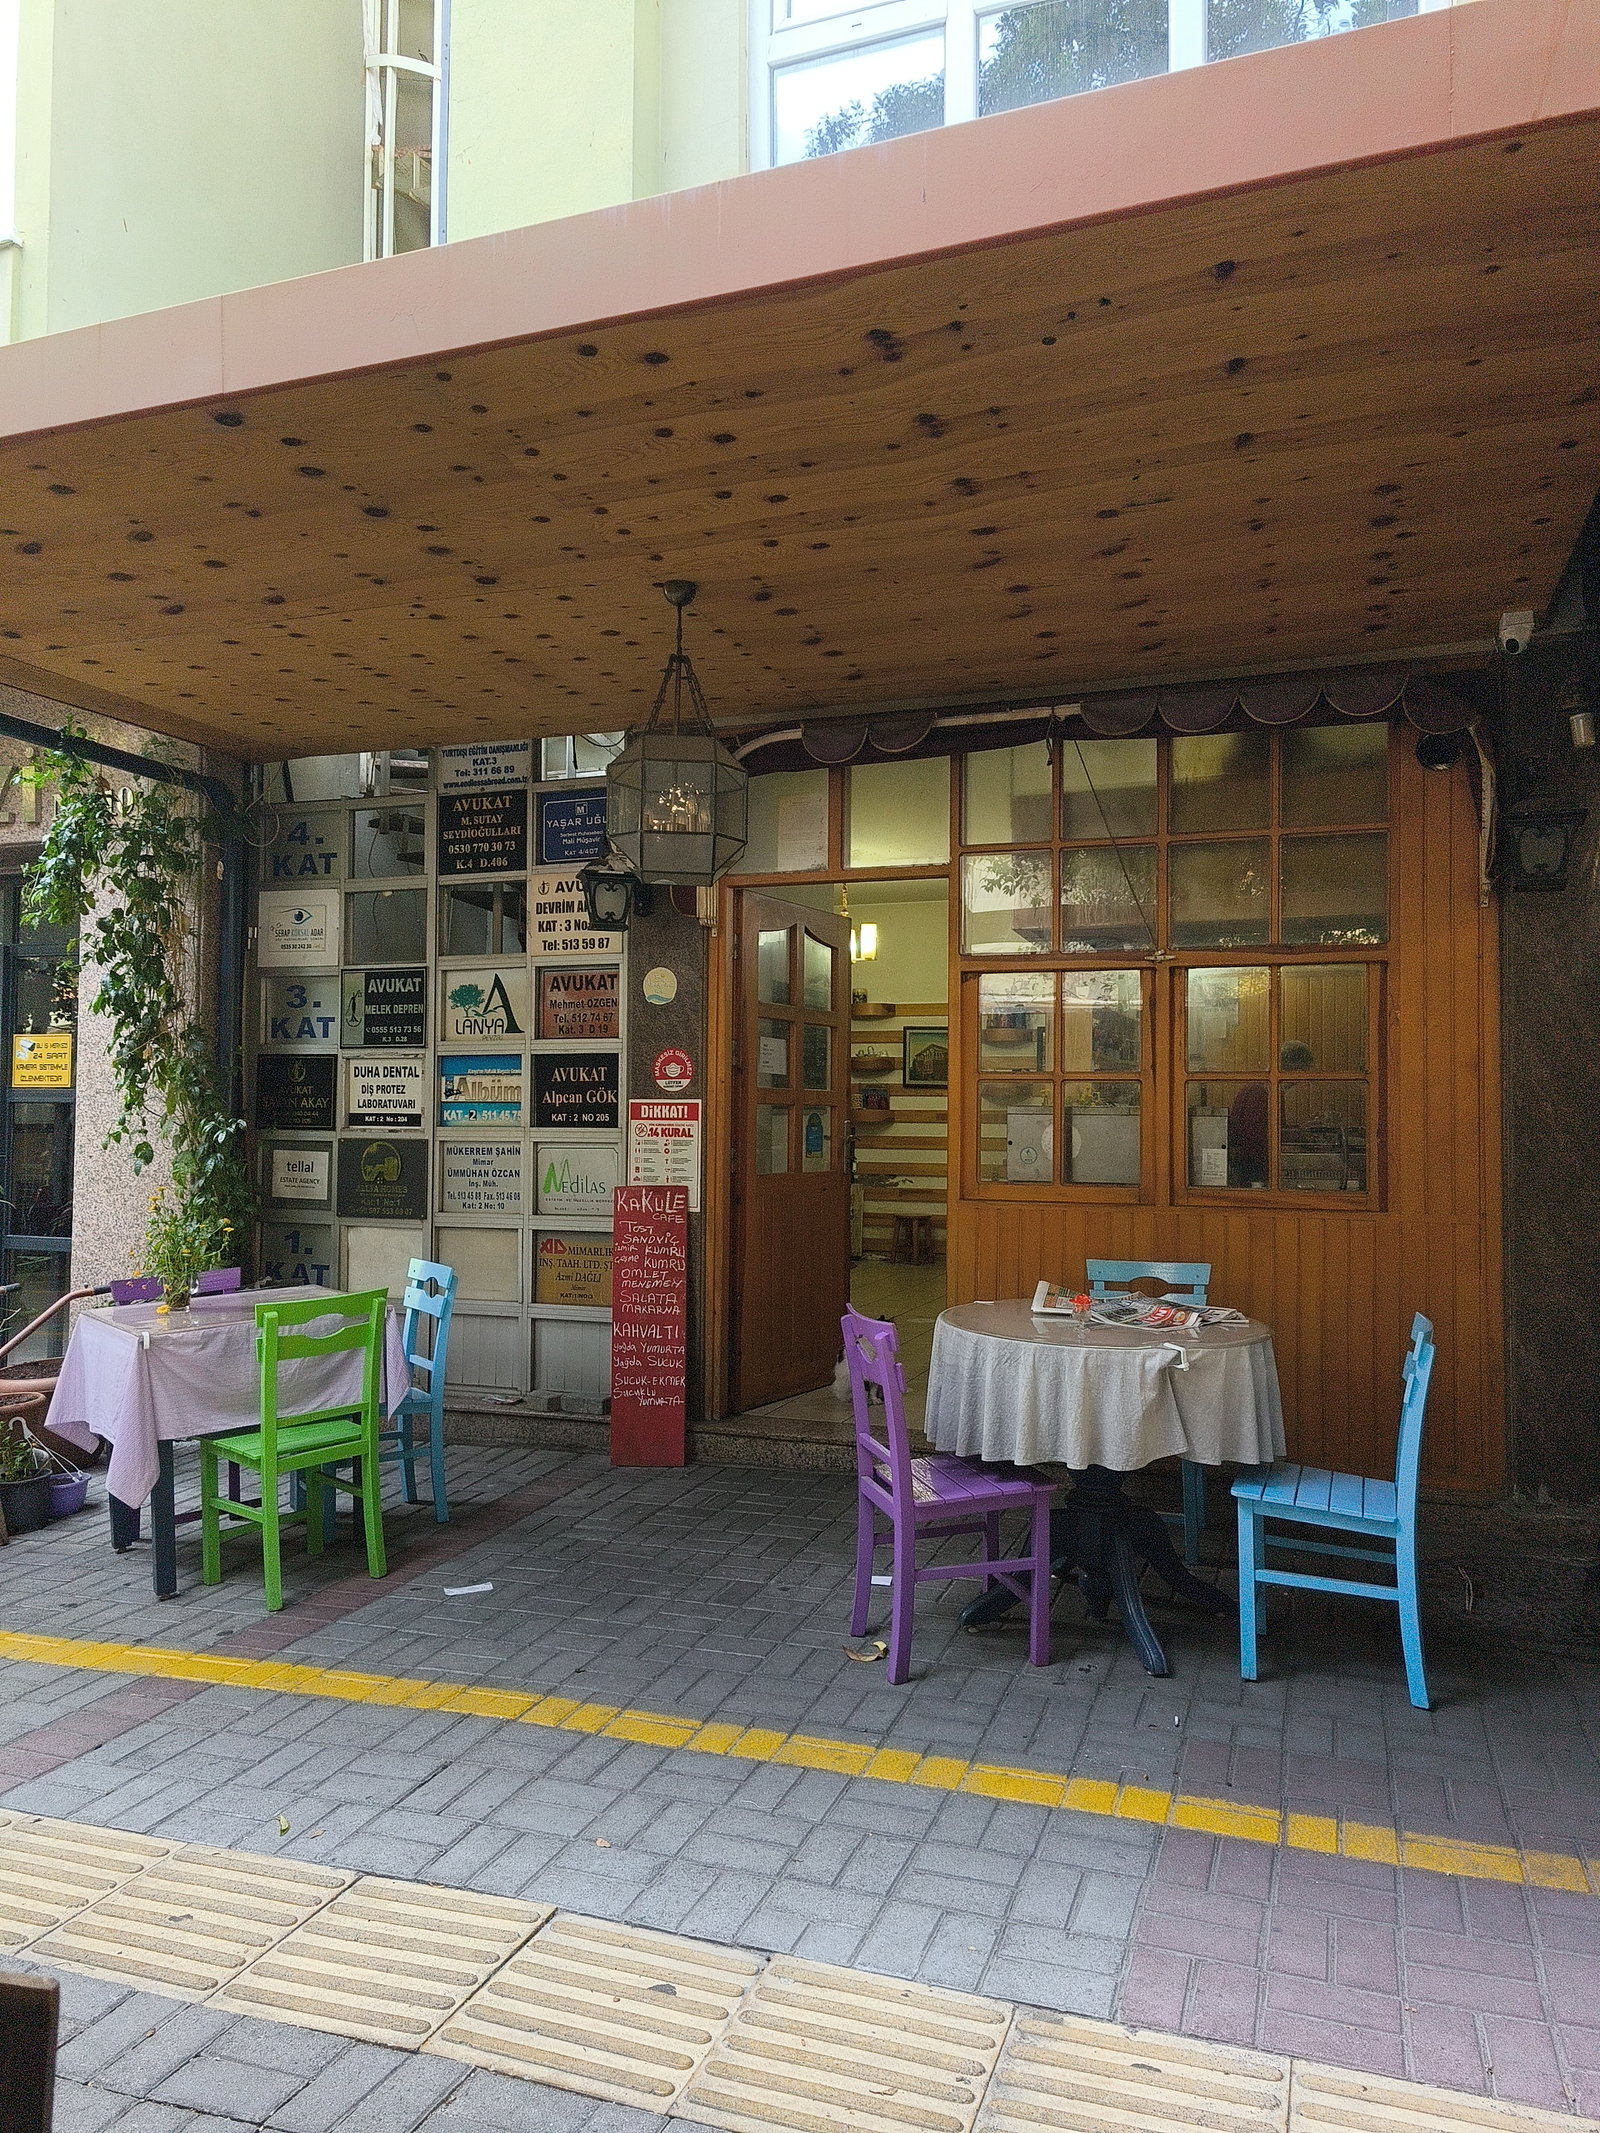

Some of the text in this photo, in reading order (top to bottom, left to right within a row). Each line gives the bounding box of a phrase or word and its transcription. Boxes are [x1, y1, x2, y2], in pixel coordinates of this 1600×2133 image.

[472, 757, 497, 766] KAT.3
[455, 769, 470, 777] Tel:
[473, 768, 487, 776] 311
[452, 796, 512, 811] AVUKAT
[461, 814, 503, 825] M. SUTAY
[547, 818, 582, 829] YAŞAR
[443, 826, 521, 840] SEYDİOĞULLARI
[448, 841, 515, 854] 0530 770 30 73
[272, 853, 337, 876] KAT
[480, 857, 508, 867] D.406
[555, 881, 584, 893] AVU
[536, 899, 574, 914] DEVRİM
[538, 920, 557, 932] KAT
[565, 920, 571, 931] 3
[542, 937, 610, 951] Tel: 513 59 87
[368, 978, 421, 993] AVUKAT
[549, 974, 617, 992] AVUKAT
[286, 985, 321, 1008] 3.
[365, 1004, 424, 1014] MELEK DEPREN
[550, 1000, 584, 1009] Mehmet
[572, 1013, 587, 1022] 512
[591, 1012, 600, 1022] 74
[603, 1012, 613, 1021] 67
[271, 1017, 335, 1038] KAT
[372, 1026, 388, 1034] 0555
[559, 1025, 608, 1034] Kat. 3 D 19
[354, 1066, 419, 1078] DUHA DENTAL
[551, 1067, 608, 1082] AVUKAT
[362, 1082, 406, 1096] DİŞ PROTEZ
[454, 1077, 521, 1100] Albüm
[301, 1097, 329, 1108] AKAY
[542, 1087, 617, 1106] Alpcan GÖK
[358, 1099, 416, 1109] LABORATUVARI
[482, 1110, 497, 1120] 511
[500, 1110, 510, 1120] 45
[661, 1128, 694, 1137] KURAL
[446, 1146, 520, 1157] MÜKERREM ŞAHİN
[287, 1161, 314, 1172] tellal
[447, 1168, 520, 1177] ÜMMÜHAN ÖZCAN
[617, 1188, 685, 1213] KAKULE
[652, 1213, 685, 1224] CAFE
[284, 1231, 313, 1254] 1.
[645, 1246, 686, 1258] KUMRU
[644, 1256, 686, 1271] KUMRU
[265, 1261, 330, 1286] KAT
[575, 1271, 601, 1282] DAĞLI
[621, 1269, 669, 1280] OMLET
[620, 1290, 678, 1305] SALATA
[622, 1304, 680, 1315] MAKARNA
[614, 1321, 678, 1339] KAHVALTI
[647, 1356, 683, 1368] SUCUK
